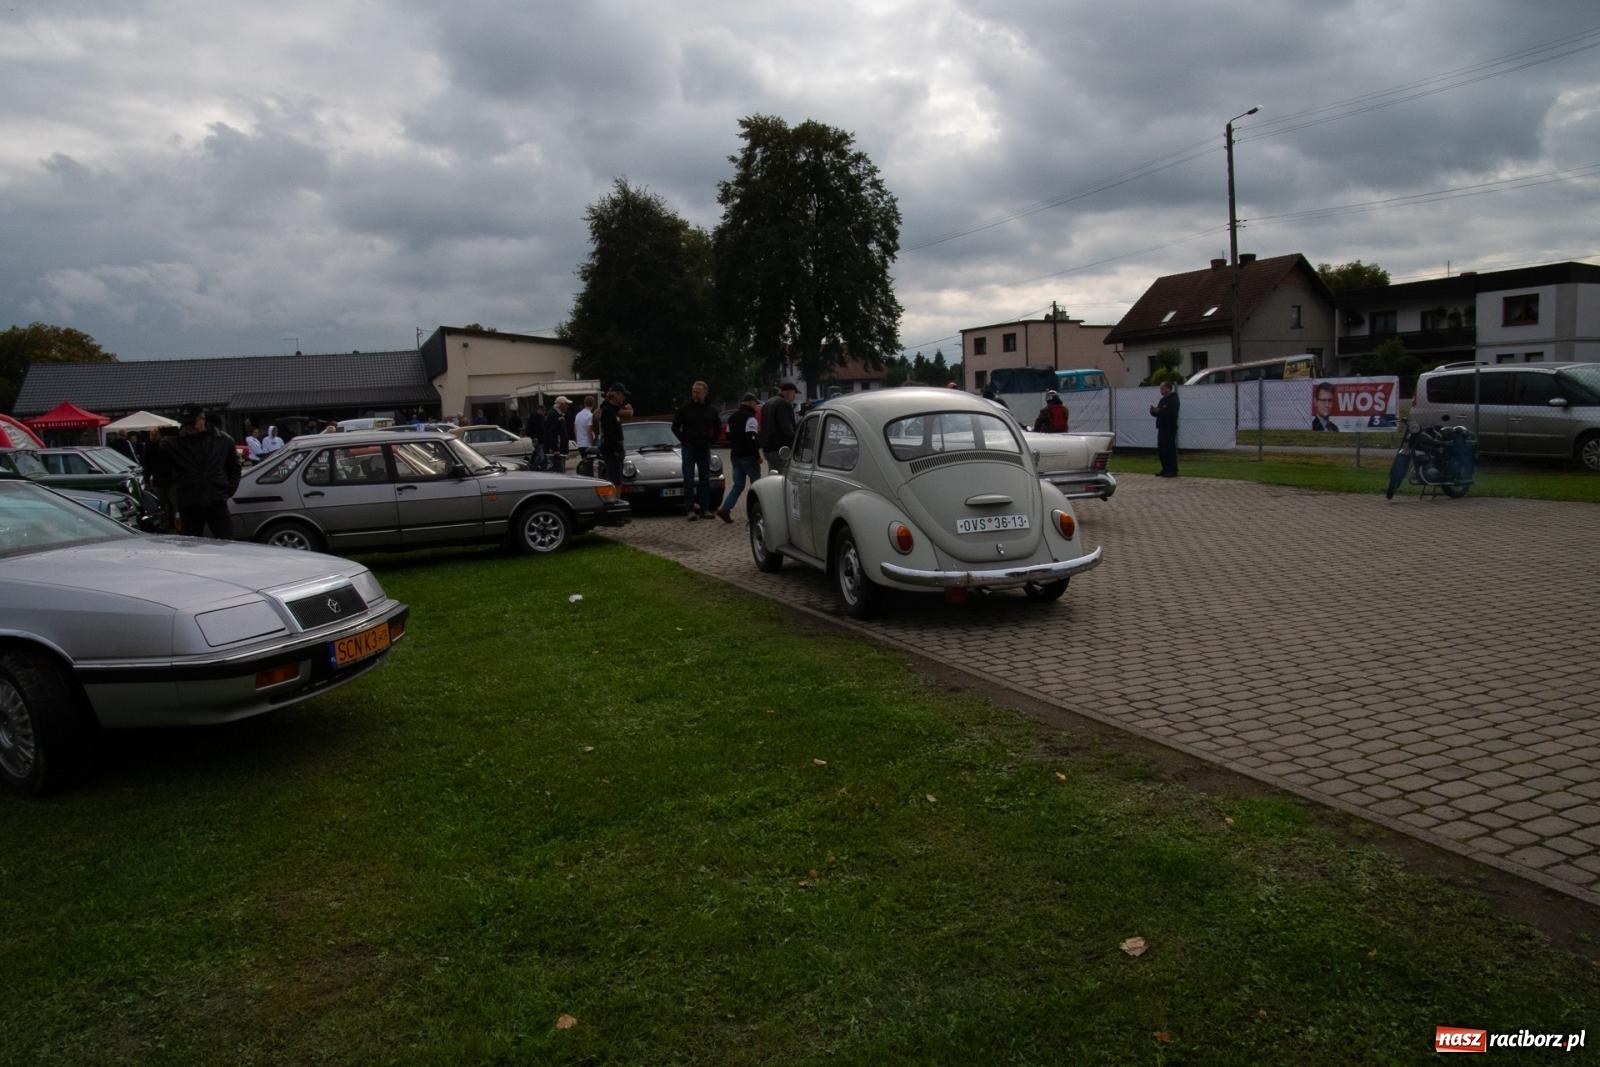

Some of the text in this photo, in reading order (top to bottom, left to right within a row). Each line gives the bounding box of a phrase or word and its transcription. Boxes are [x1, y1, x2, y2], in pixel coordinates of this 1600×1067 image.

[1337, 384, 1385, 411] WOŚ
[1372, 416, 1380, 425] 3
[963, 519, 986, 532] OVS
[338, 636, 362, 660] SCN
